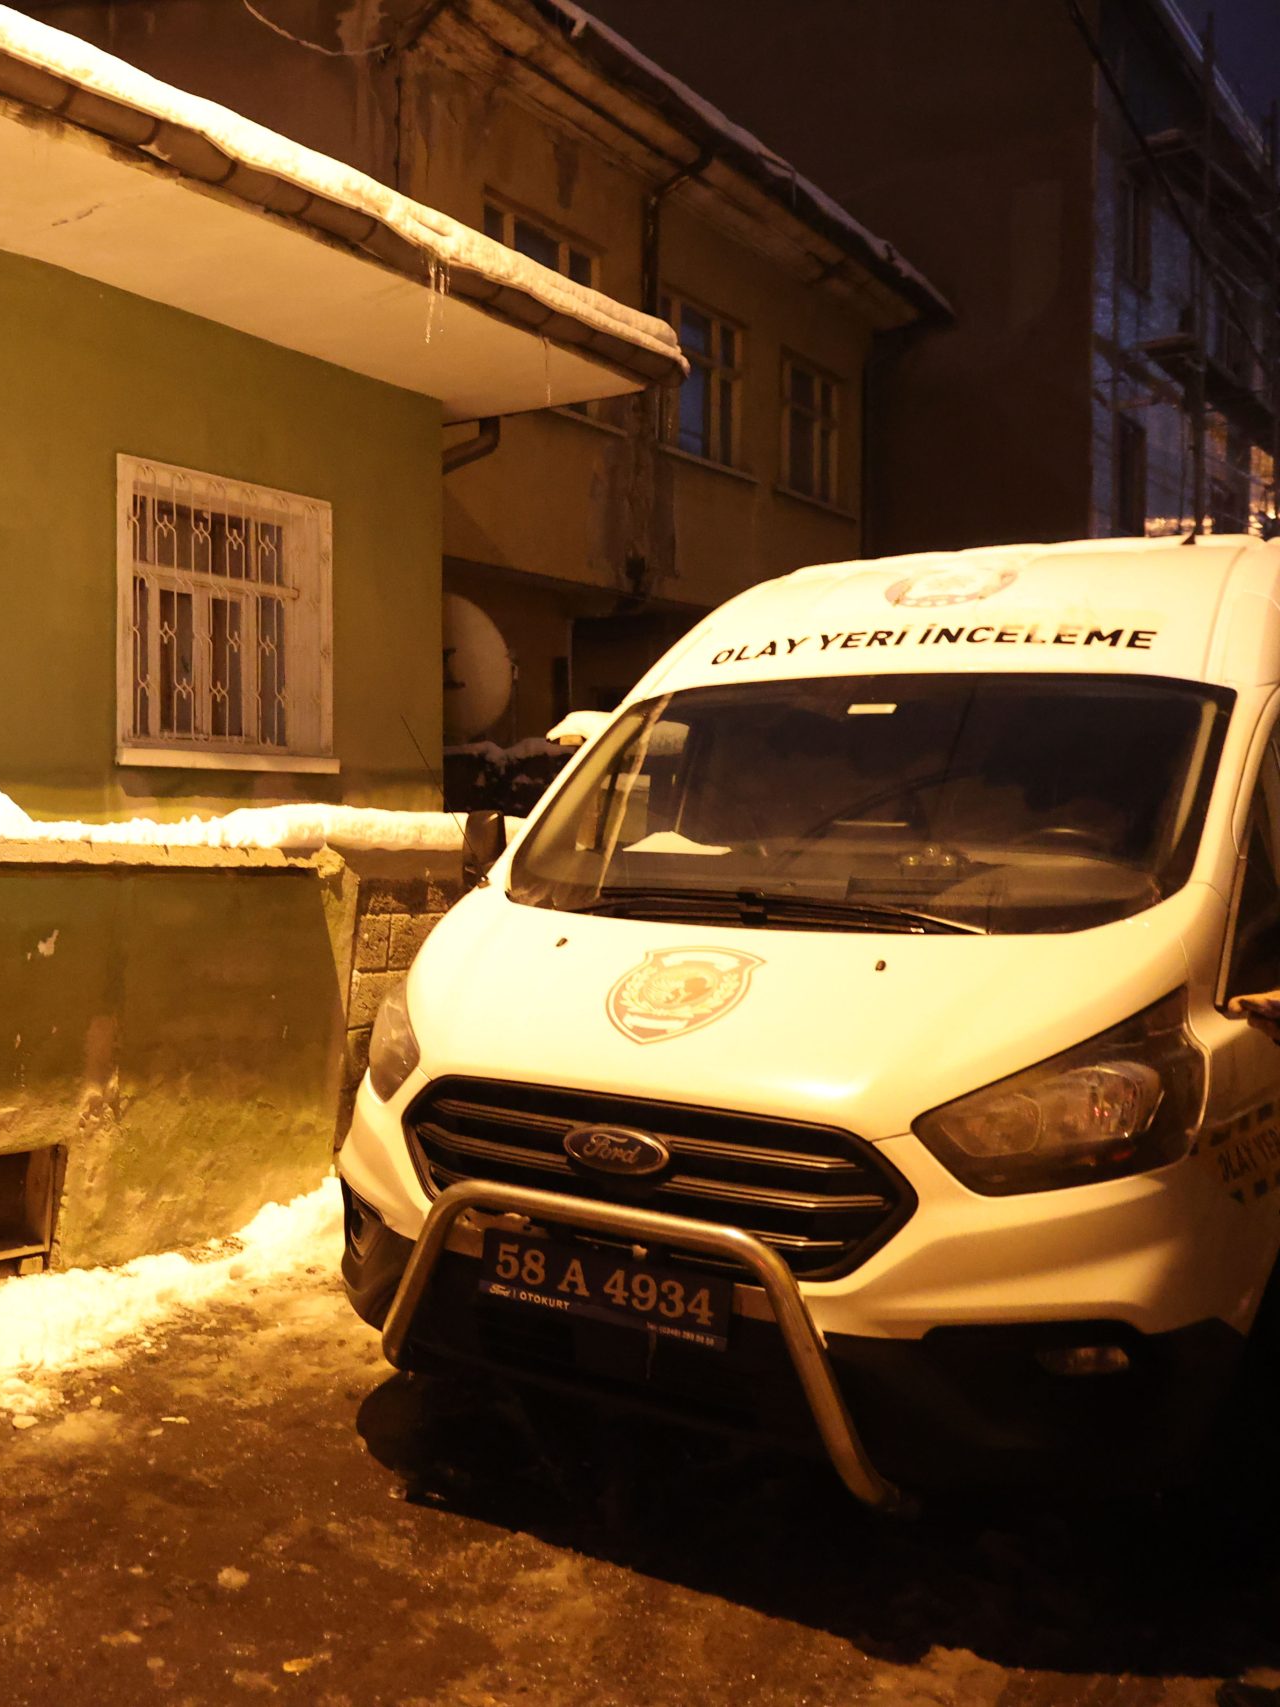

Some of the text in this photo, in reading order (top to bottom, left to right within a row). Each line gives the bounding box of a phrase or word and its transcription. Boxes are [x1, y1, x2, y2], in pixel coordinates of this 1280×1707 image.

[711, 623, 1158, 665] OLAY YERİ İNCELEME
[582, 1132, 642, 1165] Ford
[495, 1242, 715, 1327] 58 A 4934
[519, 1290, 571, 1312] OTOKURT
